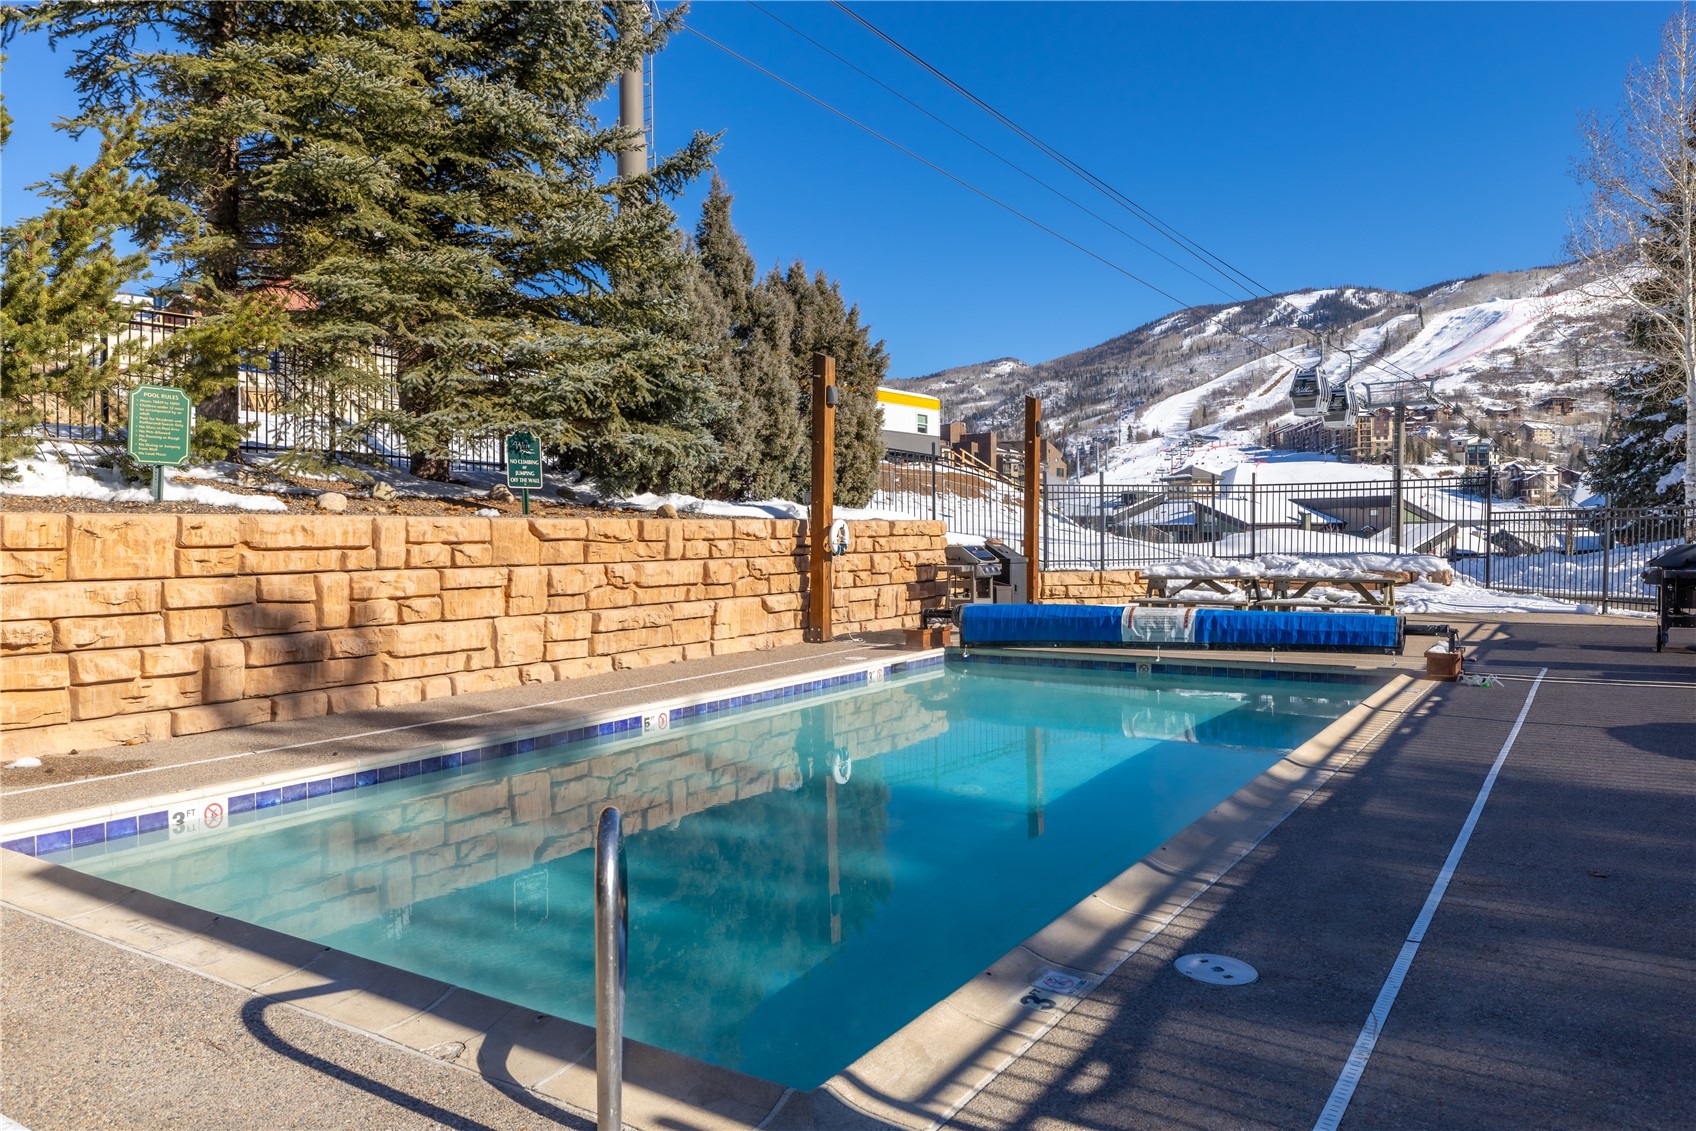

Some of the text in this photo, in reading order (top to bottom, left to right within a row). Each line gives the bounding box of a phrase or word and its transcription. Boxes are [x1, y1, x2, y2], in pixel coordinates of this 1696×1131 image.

[172, 809, 196, 826] 3 FT
[1020, 995, 1056, 1010] 3
